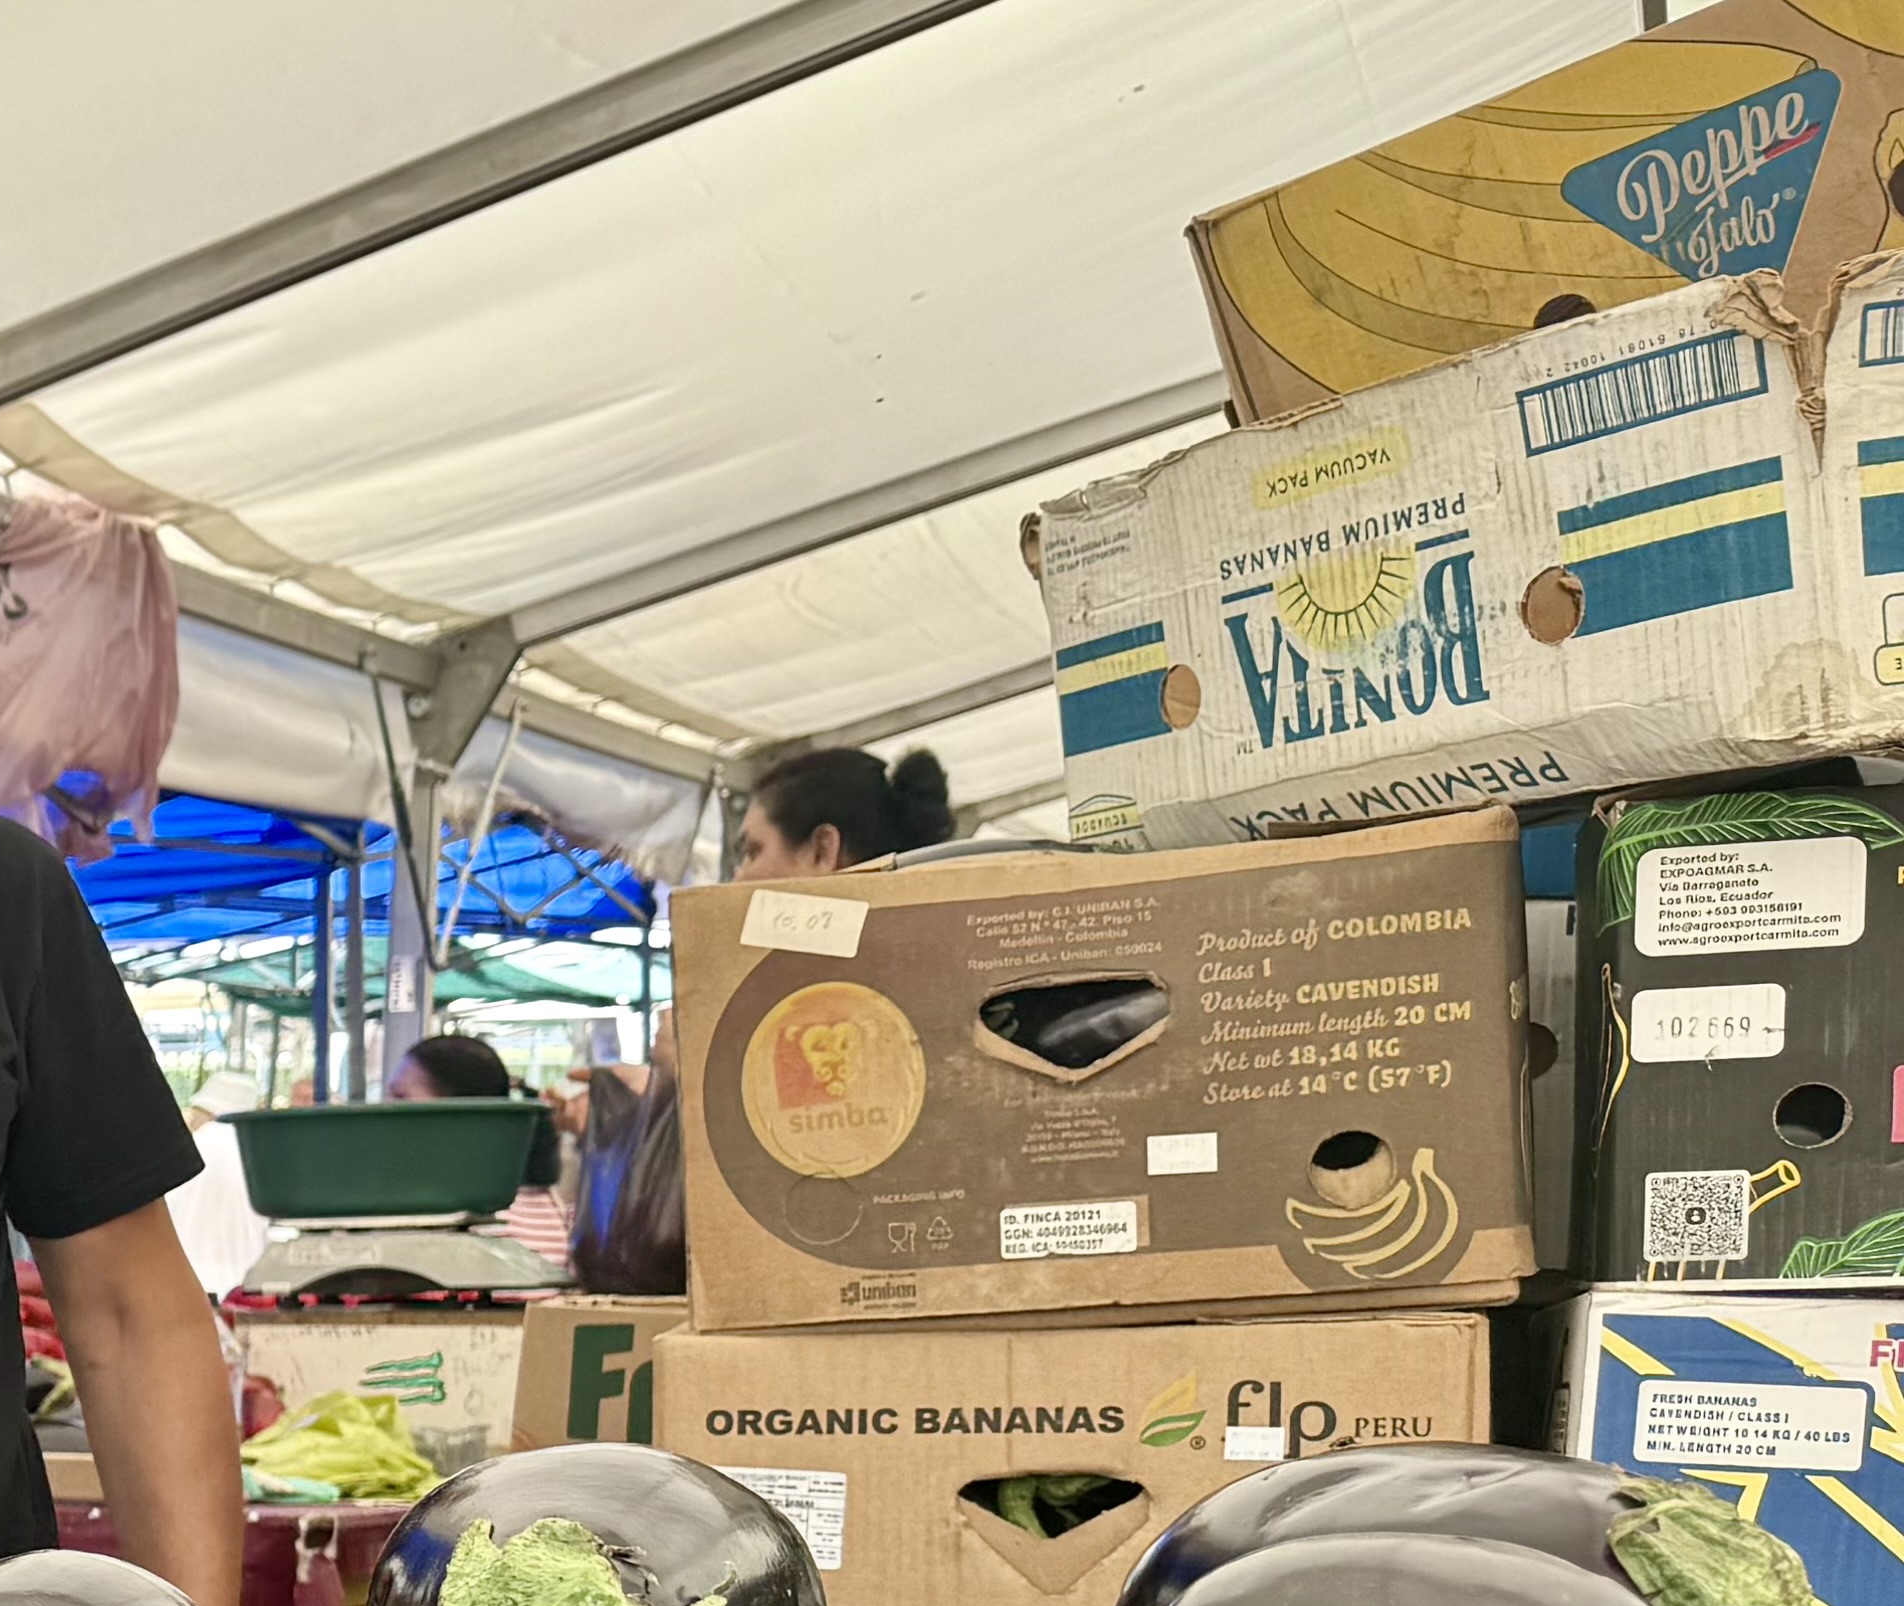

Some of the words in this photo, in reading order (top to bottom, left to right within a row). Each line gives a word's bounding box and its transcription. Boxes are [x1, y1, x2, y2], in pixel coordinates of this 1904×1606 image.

[1617, 92, 1808, 244] Peppe
[1315, 448, 1391, 483] VACUUM
[1268, 471, 1309, 498] PACK
[1342, 492, 1466, 546] PREMIUM
[1220, 529, 1331, 580] BANANAS
[1224, 551, 1490, 749] BONITA
[1347, 751, 1570, 817] PREMIUM
[1660, 853, 1717, 867] Exported
[1719, 852, 1739, 864] by:
[1659, 896, 1682, 906] Los
[1719, 890, 1774, 902] Ecuador
[967, 911, 1025, 927] Exported
[1076, 900, 1131, 915] UNIBAN
[1658, 908, 1702, 920] Phone:
[1065, 928, 1128, 943] Colombia
[1196, 928, 1287, 956] Product
[1290, 918, 1319, 951] of
[1326, 908, 1472, 941] COLOMBIA
[967, 956, 1022, 971] Registro
[1025, 953, 1050, 965] ICA
[1198, 962, 1255, 984] Class
[1200, 988, 1289, 1013] Variety
[1296, 973, 1440, 1005] CAVENDISH
[1200, 1020, 1313, 1046] Minimum
[1319, 1008, 1389, 1036] length
[1394, 1005, 1425, 1026] 20
[1433, 1001, 1472, 1022] CM
[1655, 1016, 1751, 1040] 102669
[1202, 1051, 1249, 1075] Net
[1253, 1049, 1283, 1068] wt
[1289, 1044, 1357, 1067] 18,14
[1367, 1037, 1400, 1060] KG
[1202, 1080, 1265, 1105] Store
[1268, 1078, 1293, 1098] at
[789, 1103, 888, 1134] simba
[1023, 1211, 1061, 1225] FINCA
[1697, 1395, 1758, 1408] BANANAS
[704, 1405, 898, 1437] ORGANIC
[913, 1404, 1125, 1435] BANANAS
[1354, 1416, 1433, 1439] PERU
[1649, 1407, 1725, 1421] CAVENDISH
[1738, 1411, 1781, 1424] CLASS
[1648, 1423, 1674, 1437] NET
[1676, 1425, 1730, 1438] WEIGHT
[1679, 1441, 1732, 1454] LENGTH
